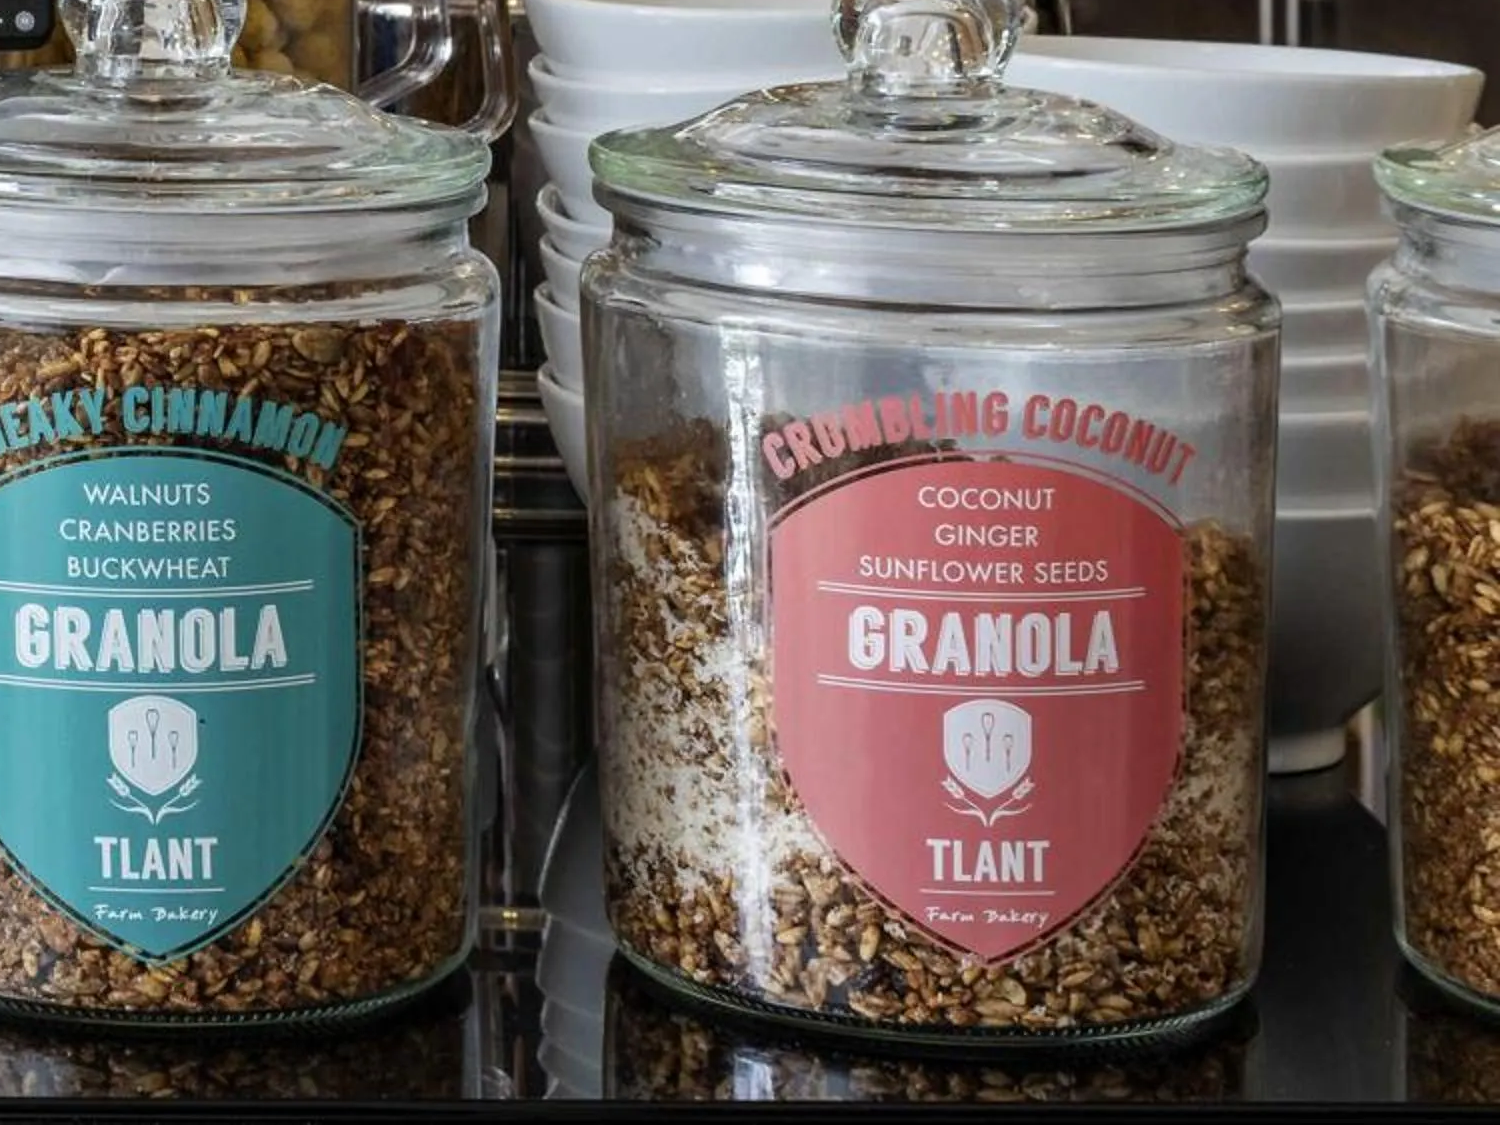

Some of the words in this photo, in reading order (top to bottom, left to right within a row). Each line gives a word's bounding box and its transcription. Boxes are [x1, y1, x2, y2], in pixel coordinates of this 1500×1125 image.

[122, 385, 348, 471] CINNAMON
[761, 390, 1010, 480] CRUMBLING
[1022, 393, 1197, 486] COCONUT
[83, 483, 211, 507] WALNUTS
[918, 486, 1056, 511] COCONUT
[59, 519, 236, 543] CRANBERRIES
[934, 524, 1039, 548] GINGER
[66, 556, 231, 580] BUCKWHEAT
[859, 555, 1024, 585] SUNFLOWER
[1034, 560, 1109, 584] SEEDS
[15, 603, 288, 673] GRANOLA
[848, 605, 1119, 677] GRANOLA
[94, 837, 219, 880] TLANT
[926, 838, 1051, 883] TLANT
[94, 904, 142, 920] Farm
[154, 904, 219, 926] Bakery
[926, 906, 975, 922] Farm
[983, 907, 1049, 928] Bakery
